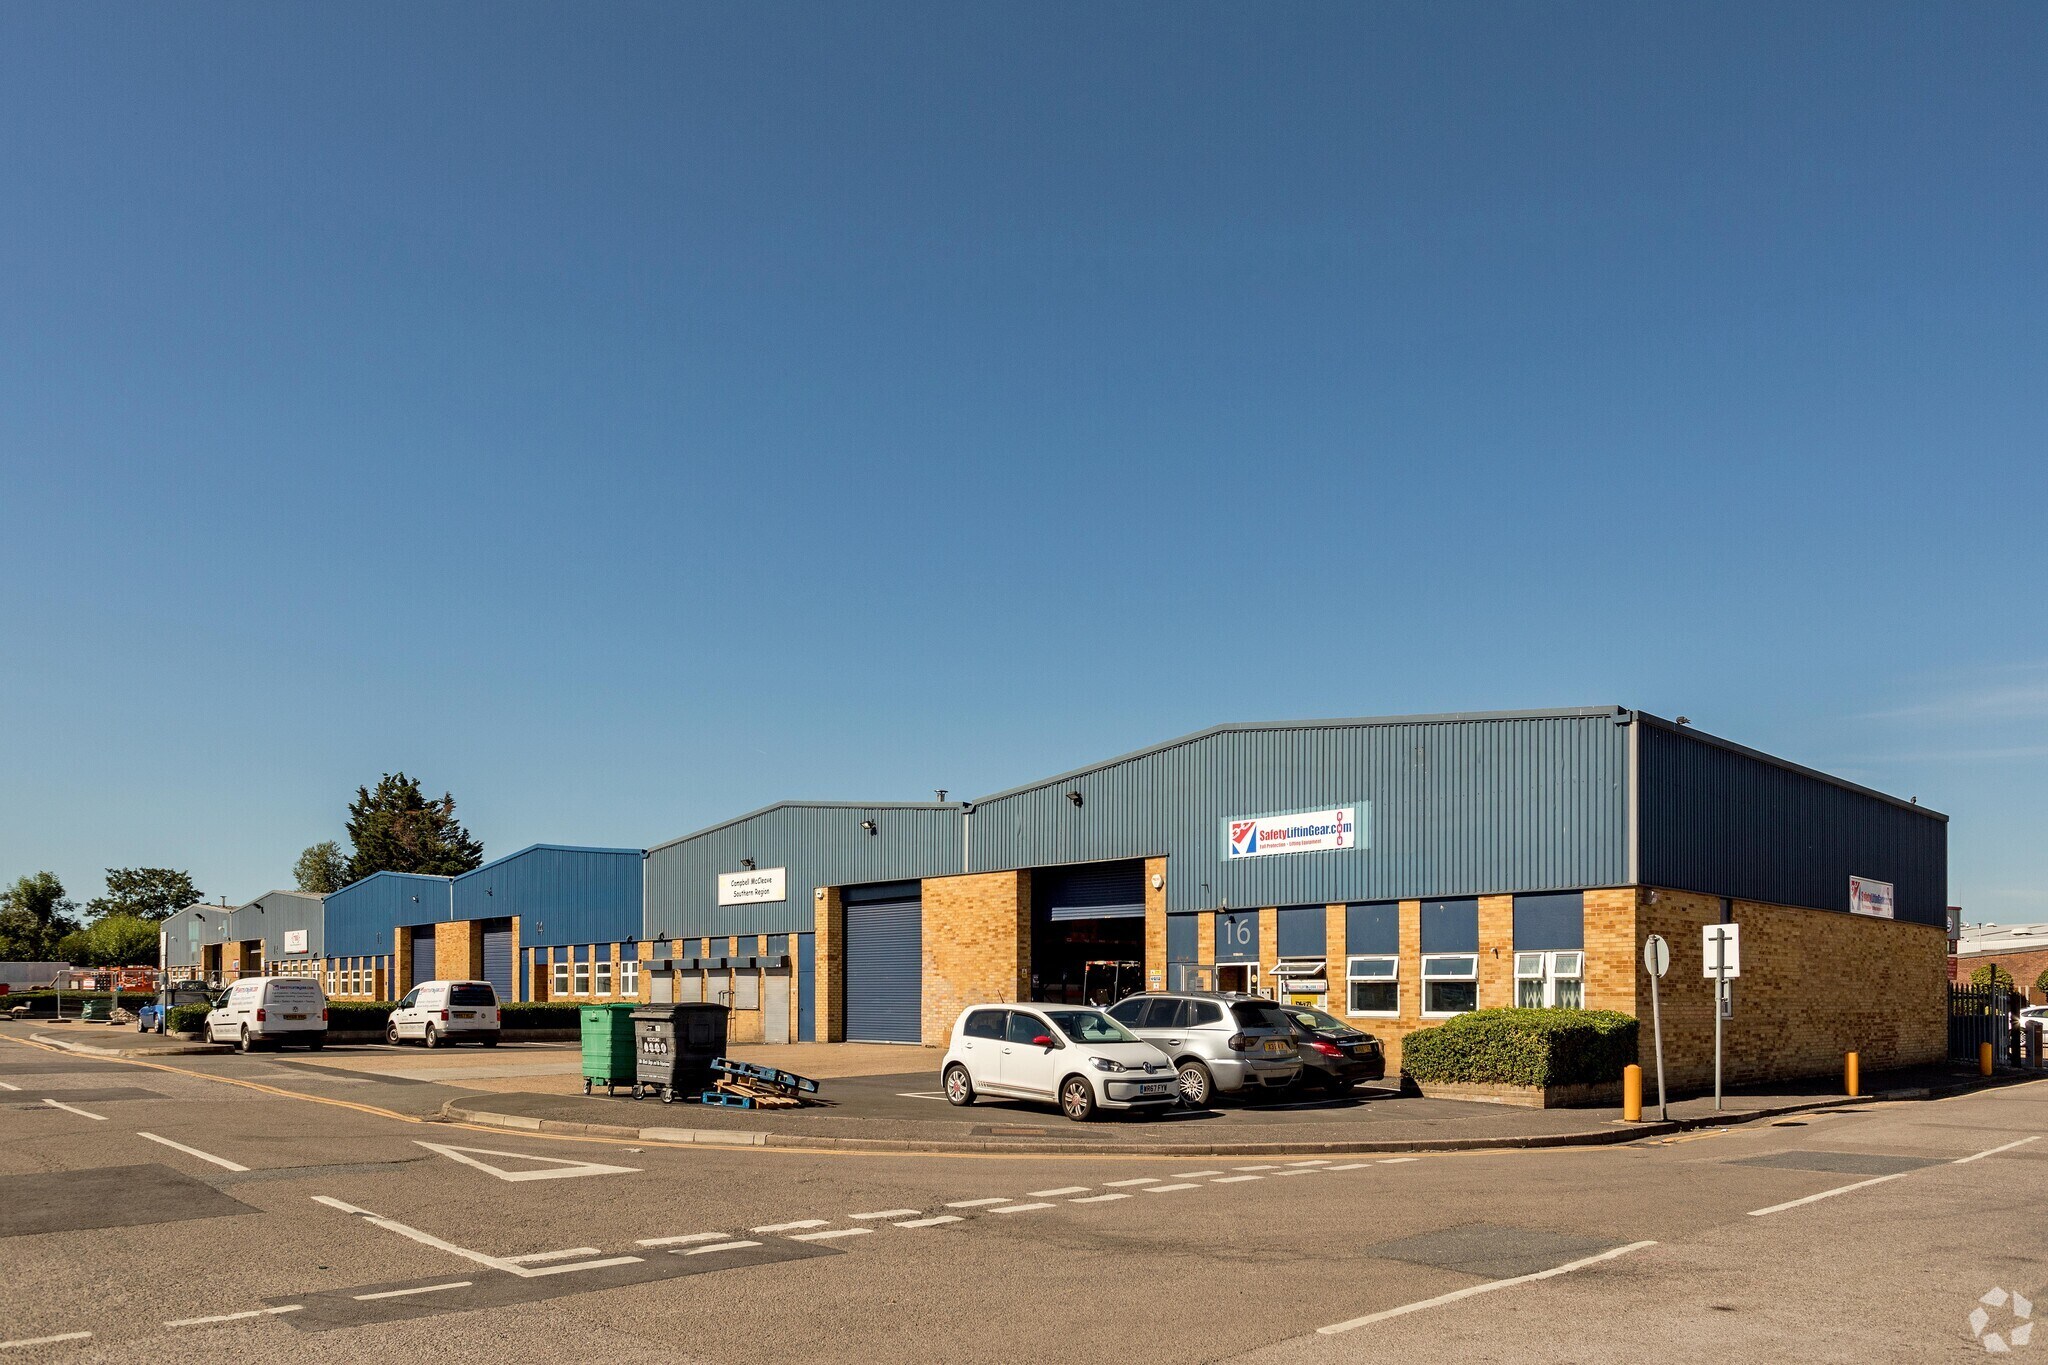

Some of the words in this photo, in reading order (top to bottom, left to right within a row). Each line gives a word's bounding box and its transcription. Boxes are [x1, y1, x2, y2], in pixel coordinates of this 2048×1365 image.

[1259, 822, 1352, 842] SafetyLiftinGear.com
[1267, 841, 1286, 849] Protection
[730, 878, 750, 888] Campbell
[750, 877, 772, 885] McCleave
[733, 889, 754, 898] Southern
[755, 888, 770, 897] Region
[1224, 918, 1251, 945] 16
